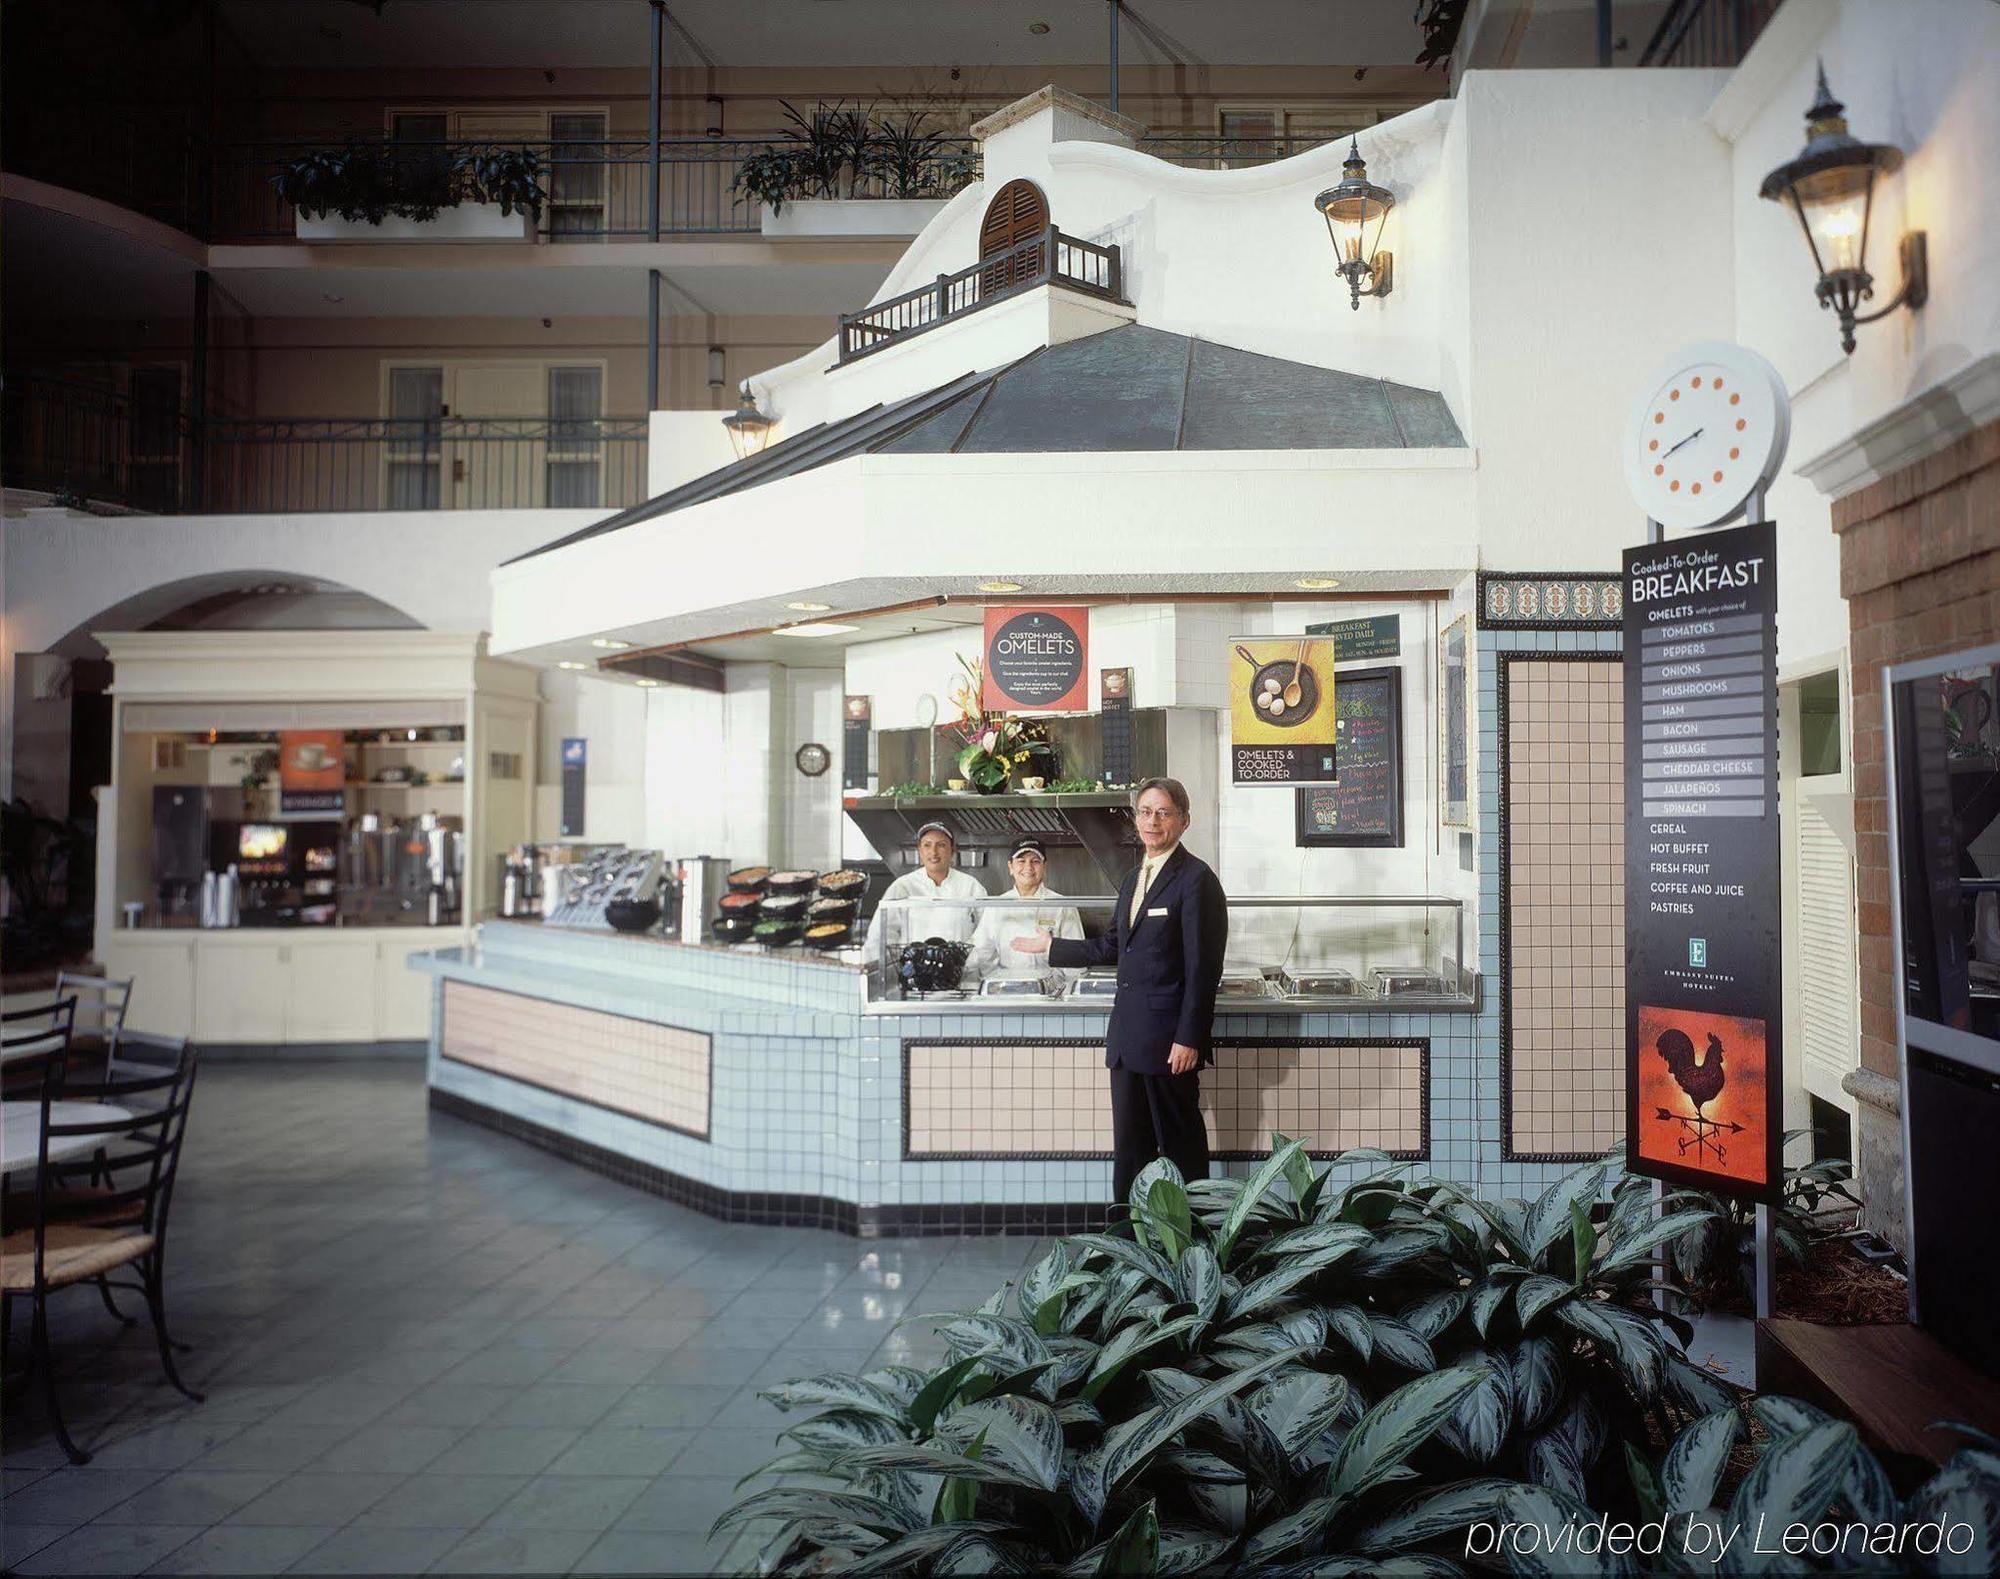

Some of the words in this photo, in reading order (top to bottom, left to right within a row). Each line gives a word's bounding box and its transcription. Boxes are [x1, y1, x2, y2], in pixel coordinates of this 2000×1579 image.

[1631, 550, 1719, 576] Cooked-To-Order
[1632, 558, 1764, 602] BREAKFAST
[1648, 605, 1694, 621] OMELETS
[1331, 621, 1371, 633] BREAKFAST
[1661, 622, 1715, 639] TOMATOES
[1334, 632, 1353, 641] RVED
[997, 639, 1075, 655] OMELETS
[1663, 643, 1705, 658] PEPPERS
[1661, 663, 1701, 677] ONIONS
[1662, 681, 1728, 697] MUSHROOMS
[1662, 705, 1684, 716] HAM
[1663, 723, 1698, 736] BACON
[1238, 750, 1285, 760] OMELETS
[1286, 750, 1295, 760] &
[1663, 743, 1707, 756] SAUSAGE
[1238, 760, 1286, 769] COOKED-
[1663, 762, 1710, 775] CHEDDAR
[1712, 761, 1753, 774] CHEESE
[1238, 769, 1290, 779] TO-ORDER
[1663, 803, 1706, 814] SPINACH
[1650, 824, 1687, 834] CEREAL
[1650, 844, 1671, 853] HOT
[1673, 844, 1710, 854] BUFFET
[1650, 863, 1680, 873] FRESH
[1682, 863, 1711, 874] FRUIT
[1650, 882, 1688, 894] COFFEE
[1691, 885, 1712, 895] AND
[1714, 885, 1745, 896] JUICE
[1650, 902, 1694, 914] PASTRIES
[1692, 942, 1704, 963] E
[1664, 969, 1702, 979] EMBASSY
[1704, 974, 1735, 982] SUITES
